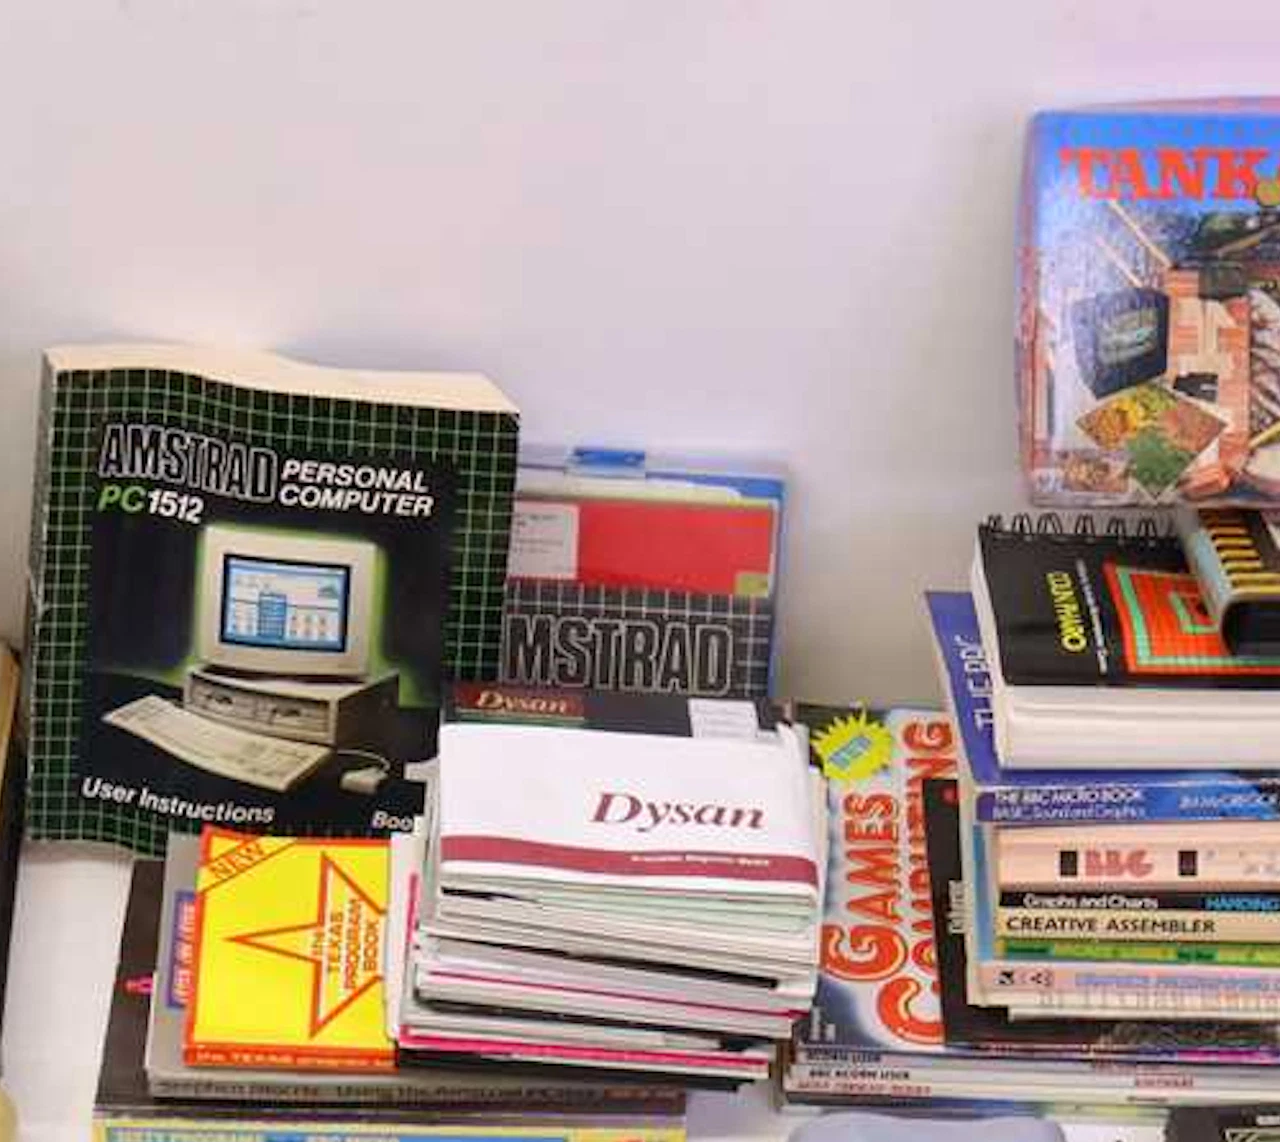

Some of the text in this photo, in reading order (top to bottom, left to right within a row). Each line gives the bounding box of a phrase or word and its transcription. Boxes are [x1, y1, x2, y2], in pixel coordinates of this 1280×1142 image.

[99, 424, 279, 501] AMSTRAD
[281, 458, 428, 494] PERSONAL
[97, 485, 205, 524] PC1512
[279, 484, 435, 517] COMPUTER
[501, 612, 734, 697] MSTRAD
[477, 690, 568, 715] Dysan
[81, 776, 275, 824] User Instructions
[589, 790, 766, 833] Dysan
[995, 788, 1142, 803] THE BBC MICRO BOOK
[372, 810, 415, 831] Boo
[210, 838, 266, 880] NEW
[1084, 849, 1154, 877] BBC
[818, 791, 906, 982] GAMES
[1022, 894, 1159, 911] Graphs and Charts
[328, 911, 344, 975] TEXAS
[1006, 915, 1217, 934] CREATIVE ASSEMBLER
[363, 918, 379, 972] BOOK
[834, 1070, 878, 1080] ACORN
[880, 1070, 910, 1081] USER
